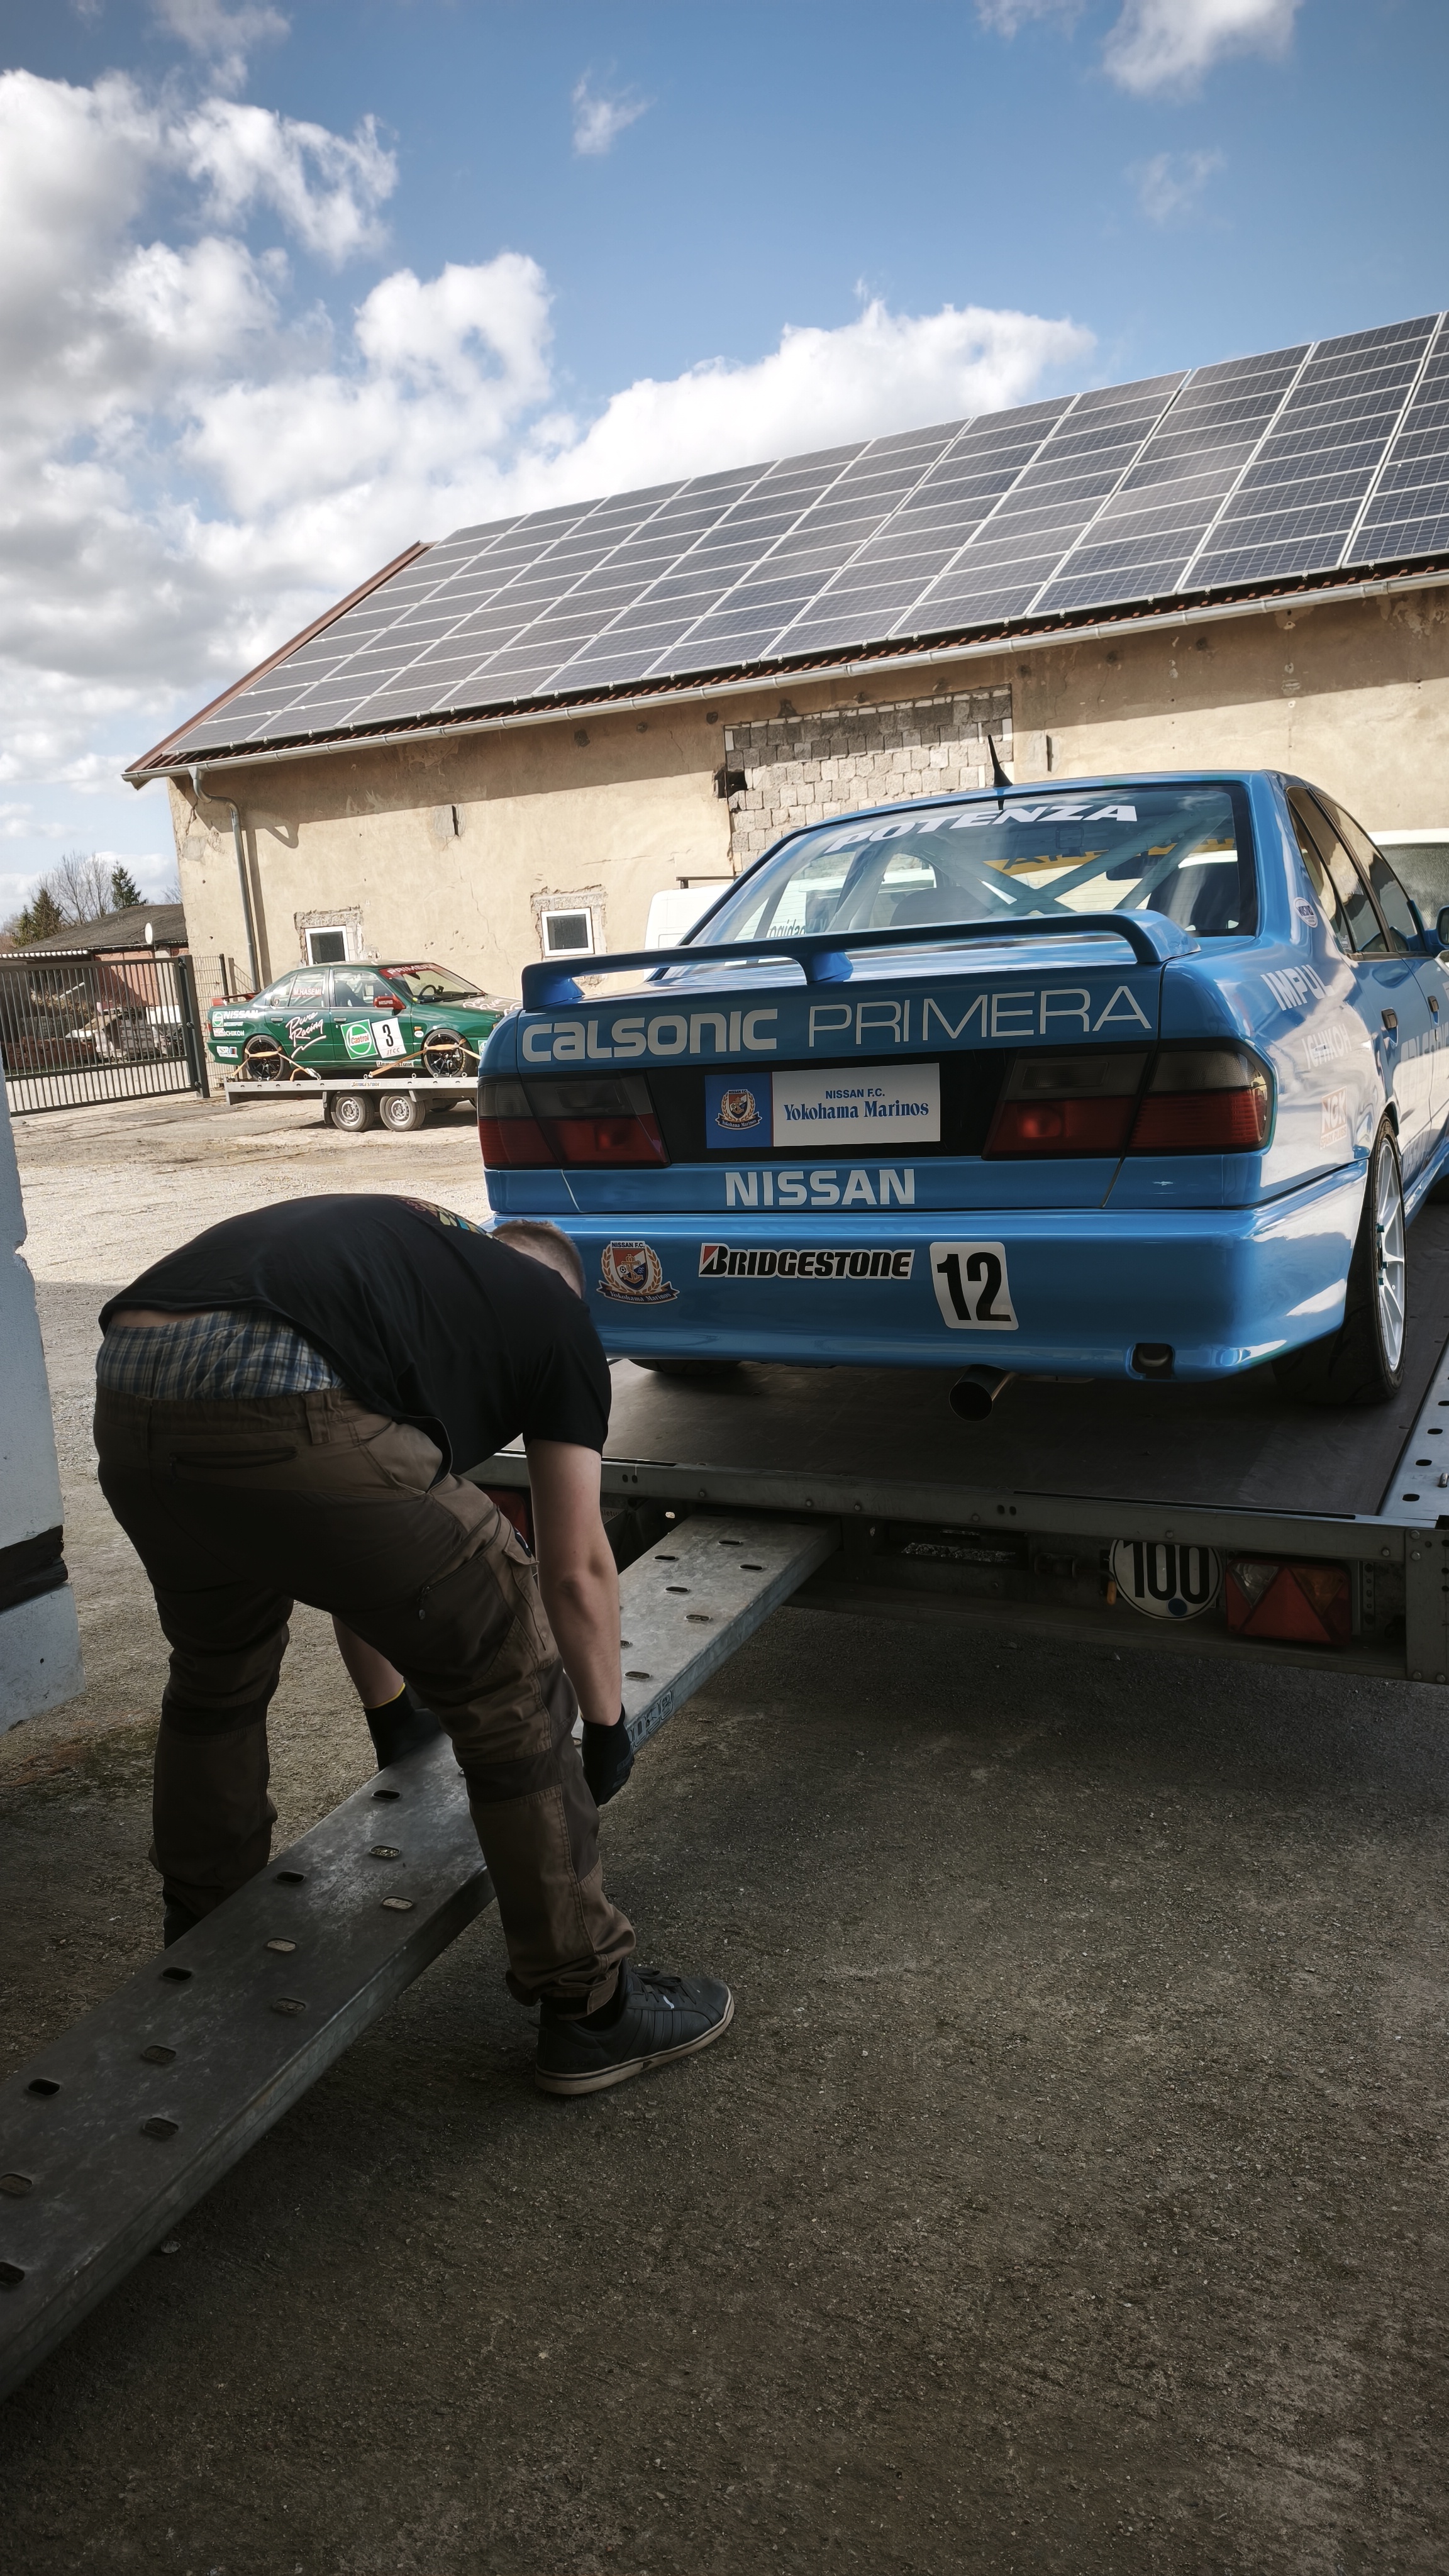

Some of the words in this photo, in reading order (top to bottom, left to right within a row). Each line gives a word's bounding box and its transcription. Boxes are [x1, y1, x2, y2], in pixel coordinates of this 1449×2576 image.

[824, 806, 1137, 853] POTENZA
[1260, 964, 1335, 1011] IMPUL
[809, 985, 1152, 1047] PRIMERA
[351, 1033, 369, 1045] Castrol
[382, 1024, 394, 1047] 3
[784, 1103, 859, 1121] Yokohama
[863, 1100, 929, 1118] Marinos
[826, 1089, 864, 1099] NISSAN
[867, 1088, 886, 1098] F.C.
[1321, 1090, 1346, 1133] NGK
[726, 1169, 915, 1206] NISSAN
[699, 1245, 913, 1277] BRIDGESTONE
[609, 1291, 645, 1302] Yokohama
[645, 1292, 672, 1302] Marinos
[937, 1252, 1012, 1322] 12
[1120, 1540, 1209, 1601] 100
